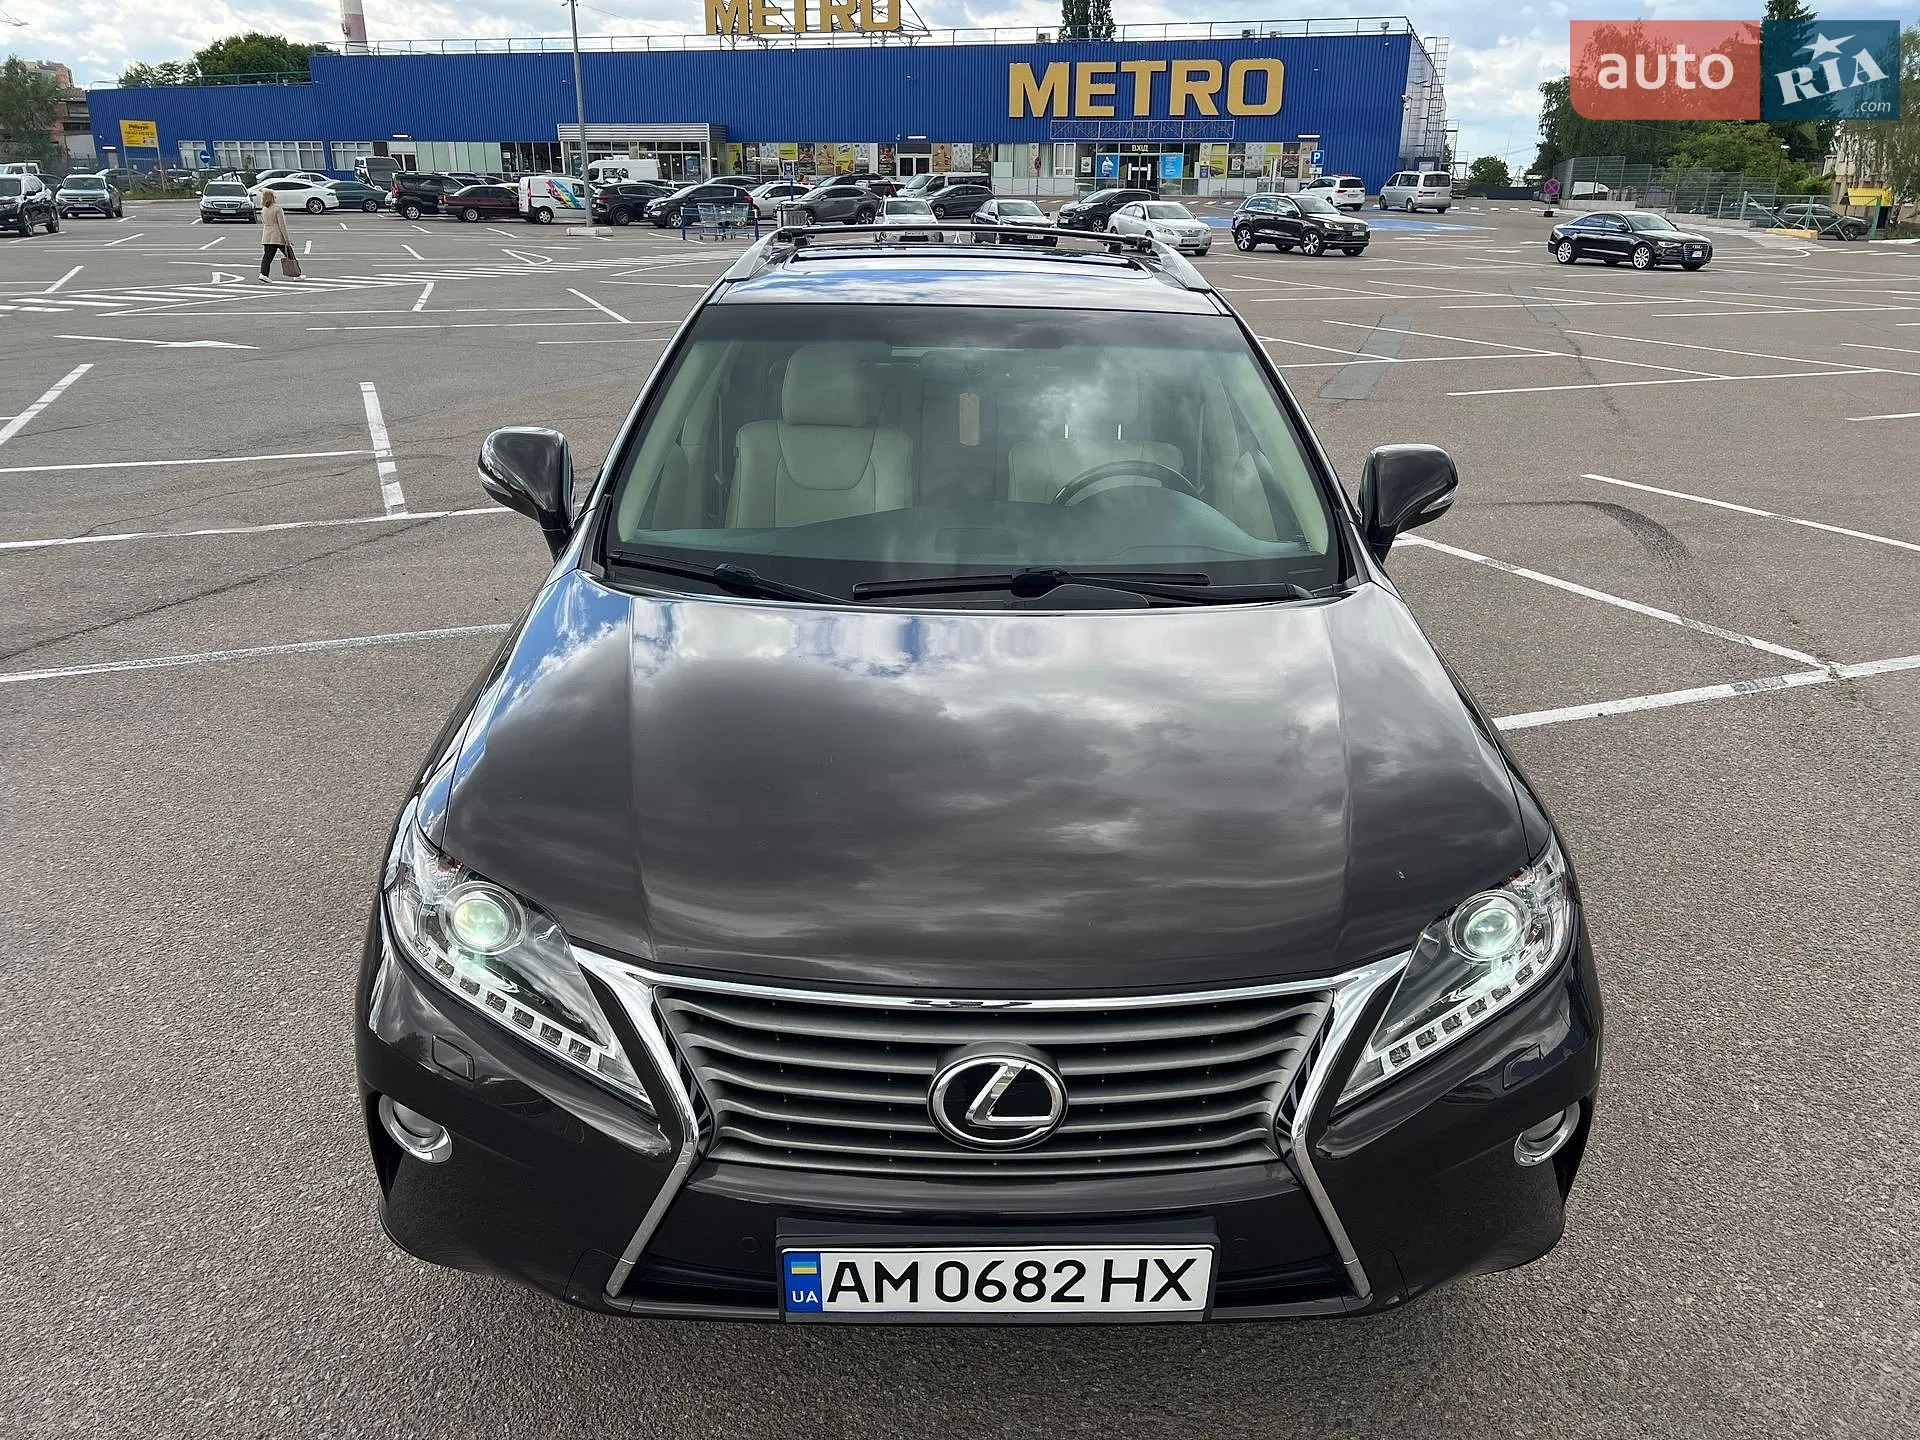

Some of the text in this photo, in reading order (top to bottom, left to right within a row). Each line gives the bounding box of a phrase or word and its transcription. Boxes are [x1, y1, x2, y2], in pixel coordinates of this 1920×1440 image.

[1008, 58, 1285, 118] METRO
[791, 1290, 819, 1303] UA
[826, 1258, 1198, 1303] AM 0682 HX
